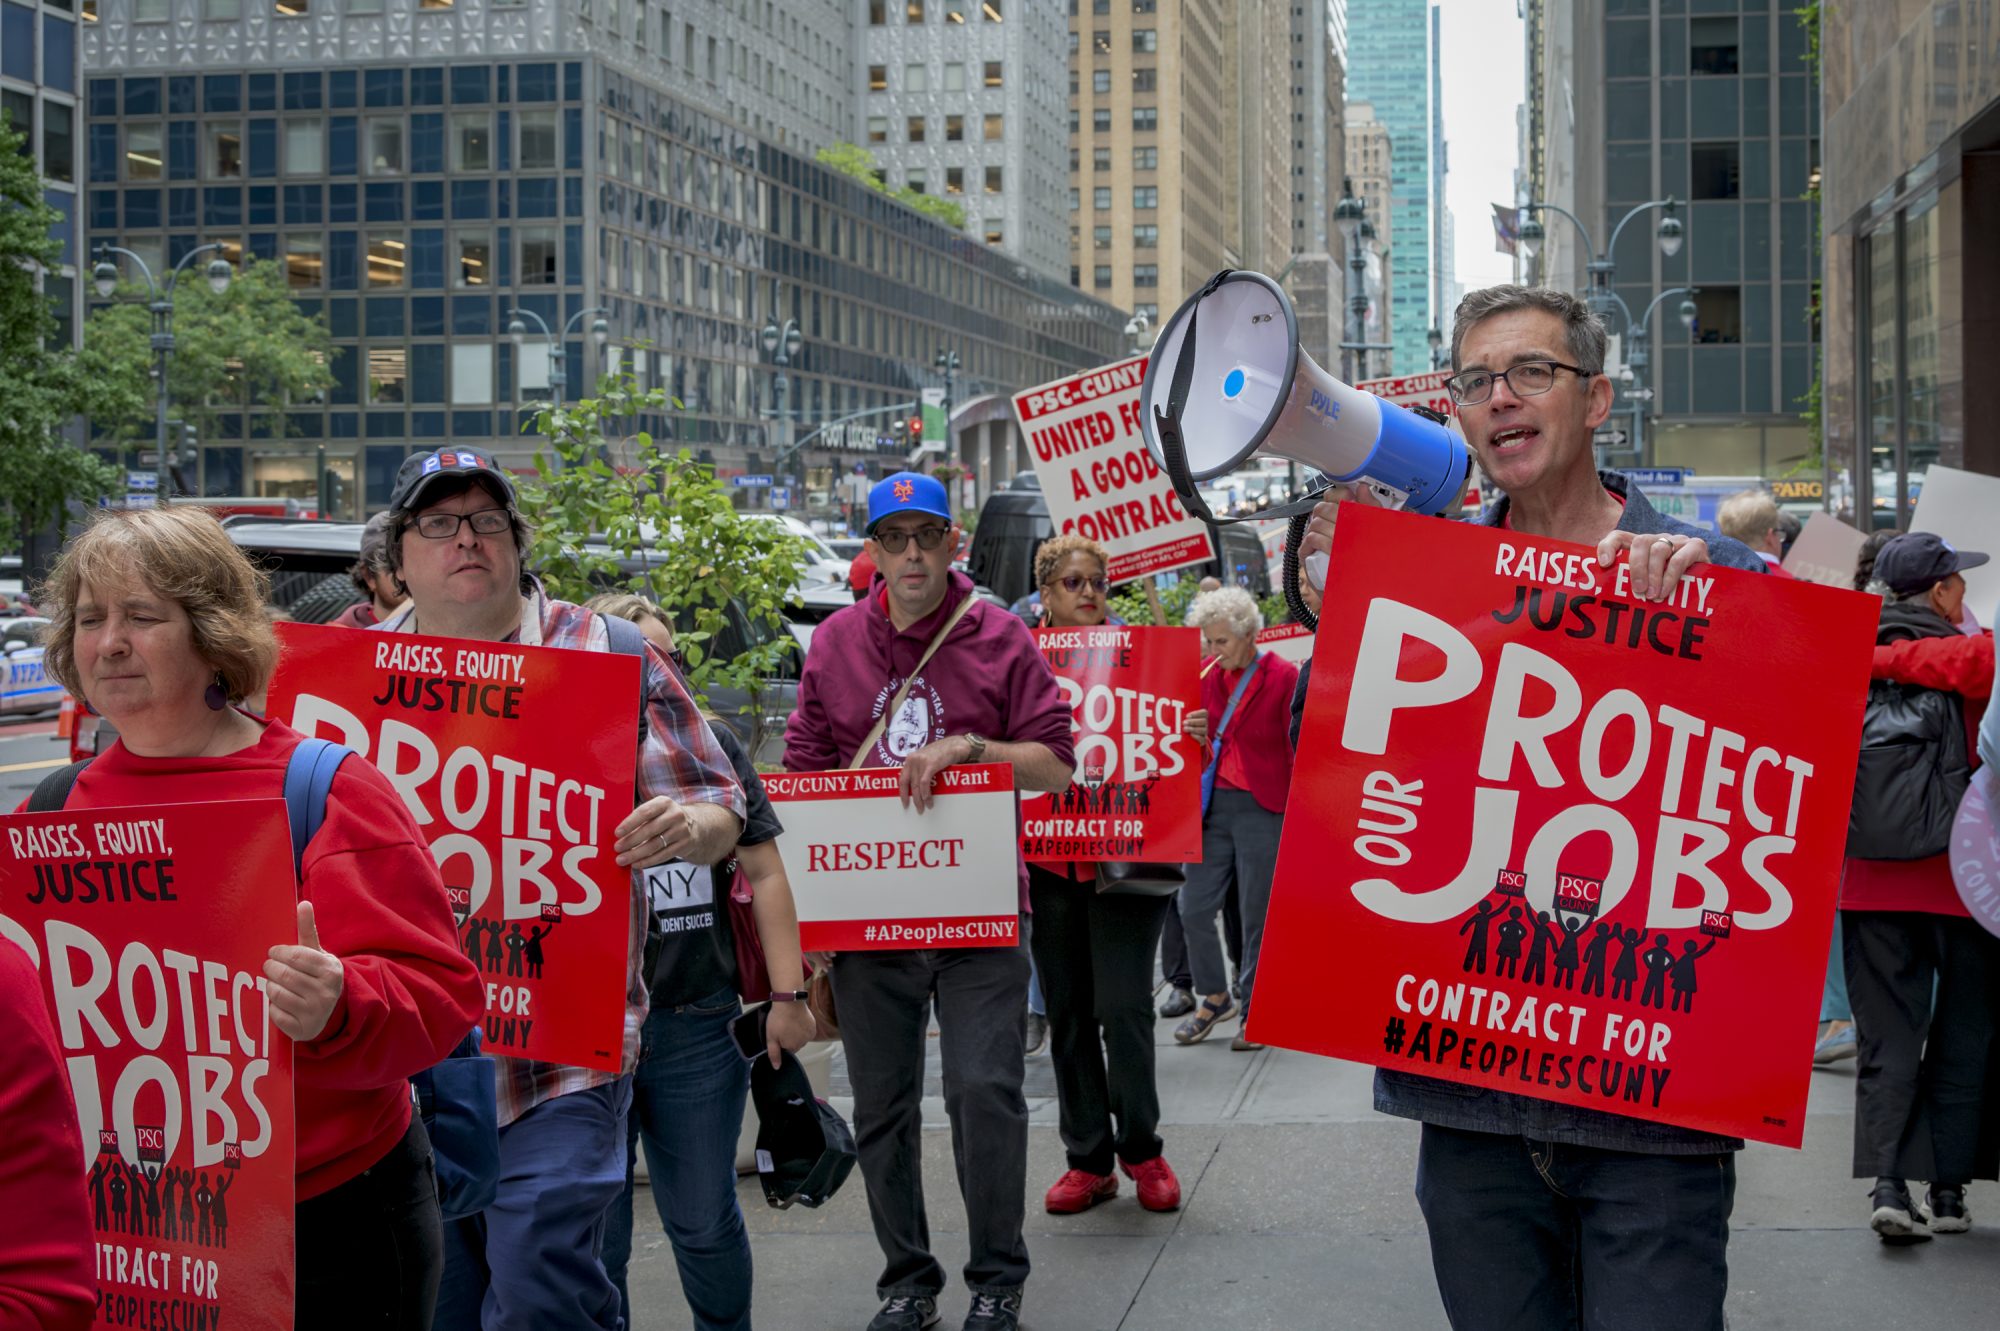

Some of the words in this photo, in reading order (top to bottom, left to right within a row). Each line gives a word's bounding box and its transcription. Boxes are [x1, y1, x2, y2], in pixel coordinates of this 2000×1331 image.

[1027, 362, 1143, 417] PSC-CUNY
[1311, 388, 1340, 421] PYLE
[1031, 411, 1115, 462] UNITED
[1118, 399, 1143, 437] FO
[1070, 468, 1091, 502] A
[1092, 448, 1159, 494] GOOD
[1062, 489, 1190, 542] CONTRAC
[1495, 543, 1602, 596] RAISES,
[1039, 631, 1085, 650] RAISES,
[1088, 630, 1133, 649] EQUITY,
[1491, 585, 1710, 661] JUSTICE
[375, 641, 447, 678] RAISES,
[455, 649, 526, 685] EQUITY,
[373, 674, 523, 719] JUSTICE
[1055, 675, 1185, 734] ROTECT
[1341, 597, 1814, 837] PROTECT
[942, 769, 990, 786] Want
[8, 822, 91, 861] RAISES,
[93, 818, 174, 858] EQUITY,
[1024, 819, 1107, 838] CONTRACT
[1114, 819, 1143, 838] FOR
[1354, 771, 1424, 866] OUR
[429, 833, 602, 920] OBS
[807, 838, 964, 872] RESPECT
[1350, 786, 1797, 931] JOBS
[26, 858, 178, 904] JUSTICE
[1499, 871, 1525, 887] PSC
[1558, 875, 1600, 901] PSC
[542, 905, 560, 916] PSC
[1559, 899, 1595, 913] CUNY
[1703, 912, 1730, 928] PSC
[864, 920, 1015, 945] #APeoplesCUNY
[0, 913, 270, 1059] ROTECT
[486, 982, 531, 1016] FOR
[1395, 974, 1587, 1046] CONTRACT
[1603, 1016, 1671, 1062] FOR
[100, 1132, 117, 1144] PSC
[137, 1128, 163, 1148] PSC
[225, 1145, 240, 1159] PSC
[182, 1255, 219, 1299] FOR
